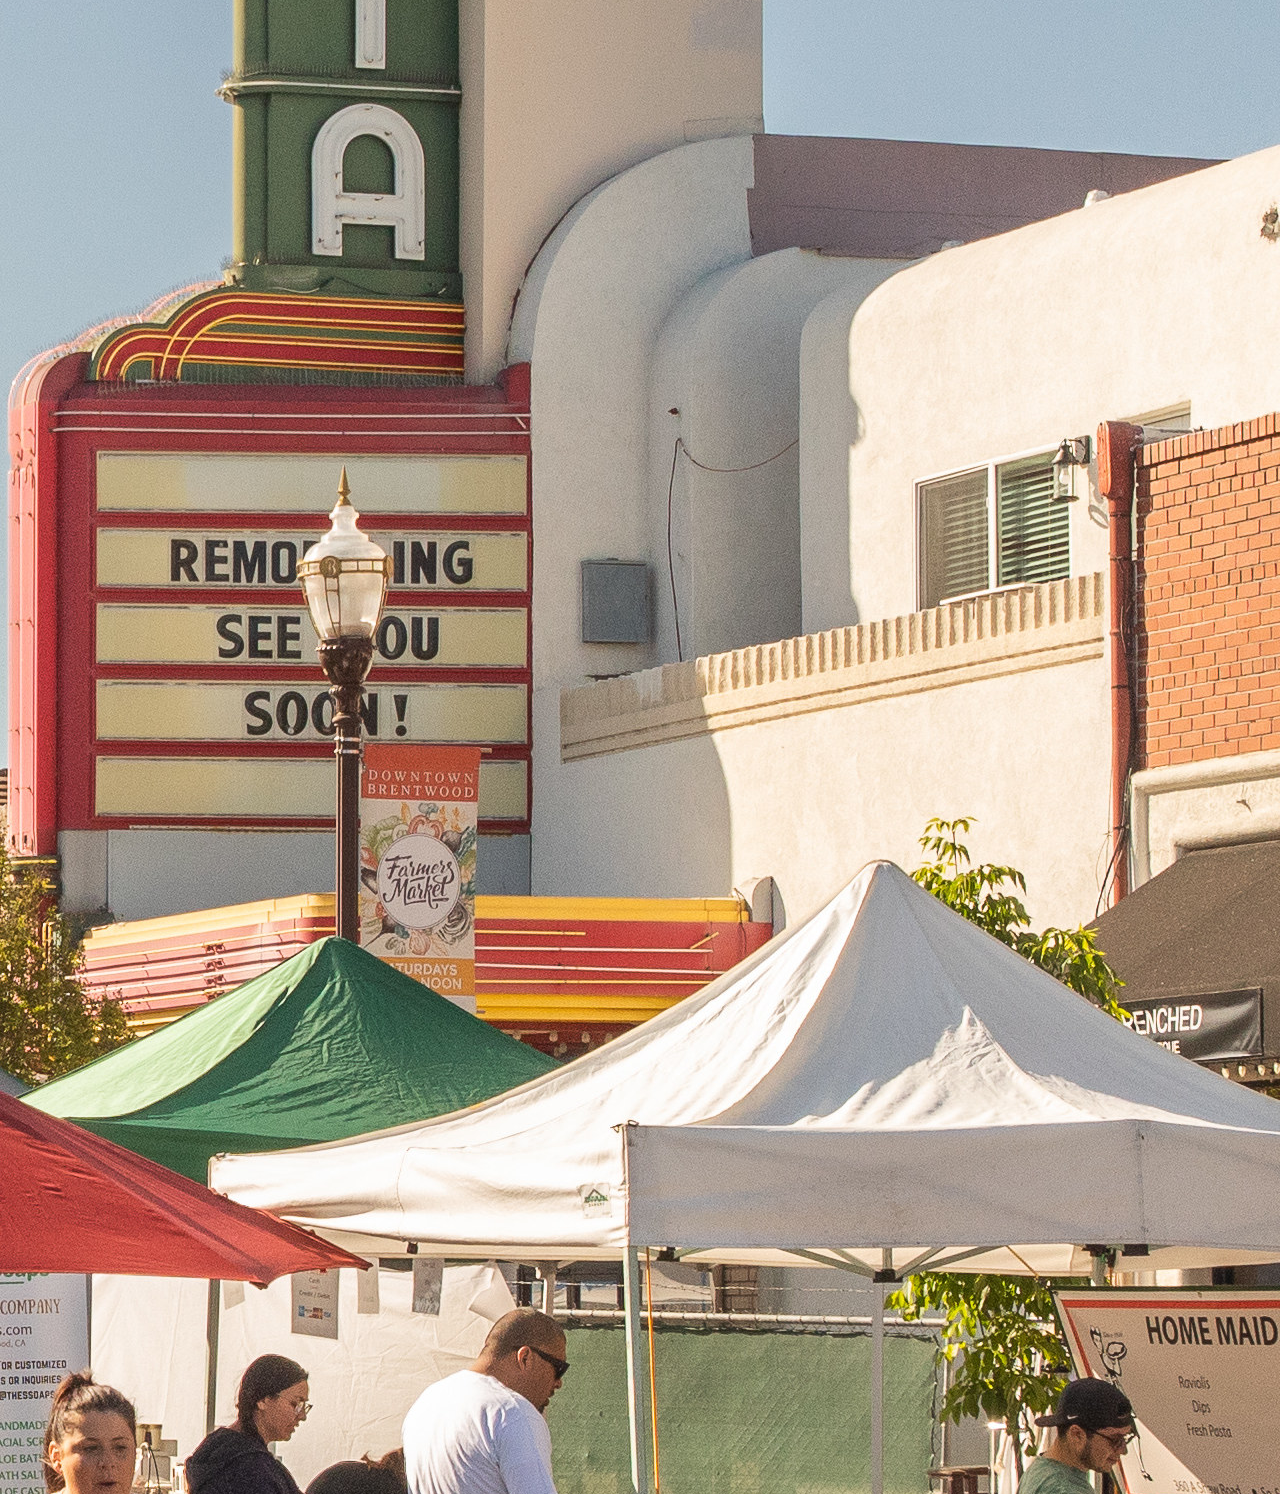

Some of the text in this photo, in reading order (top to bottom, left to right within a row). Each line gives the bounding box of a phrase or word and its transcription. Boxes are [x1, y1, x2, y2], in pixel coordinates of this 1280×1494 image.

[170, 538, 474, 585] REMOING
[216, 614, 439, 661] SEE OU
[368, 769, 474, 784] DOWNTOWN
[367, 783, 475, 798] BRENTWOOD
[385, 855, 455, 884] Farmers
[382, 876, 450, 910] Market
[389, 962, 458, 976] TURDAYS
[420, 976, 463, 990] NOON
[0, 1298, 62, 1315] COMPANY
[1145, 1315, 1279, 1346] HOME MAID
[14, 1339, 26, 1348] CA
[14, 1359, 67, 1370] CUSTOMIZED
[8, 1375, 20, 1385] OR
[21, 1374, 62, 1385] INQUIRIES
[1177, 1375, 1211, 1390] Raviolis
[1192, 1399, 1211, 1415] Dips
[1186, 1423, 1233, 1439] Fresh Pasta
[26, 1436, 45, 1446] SCR
[1172, 1479, 1190, 1492] 360
